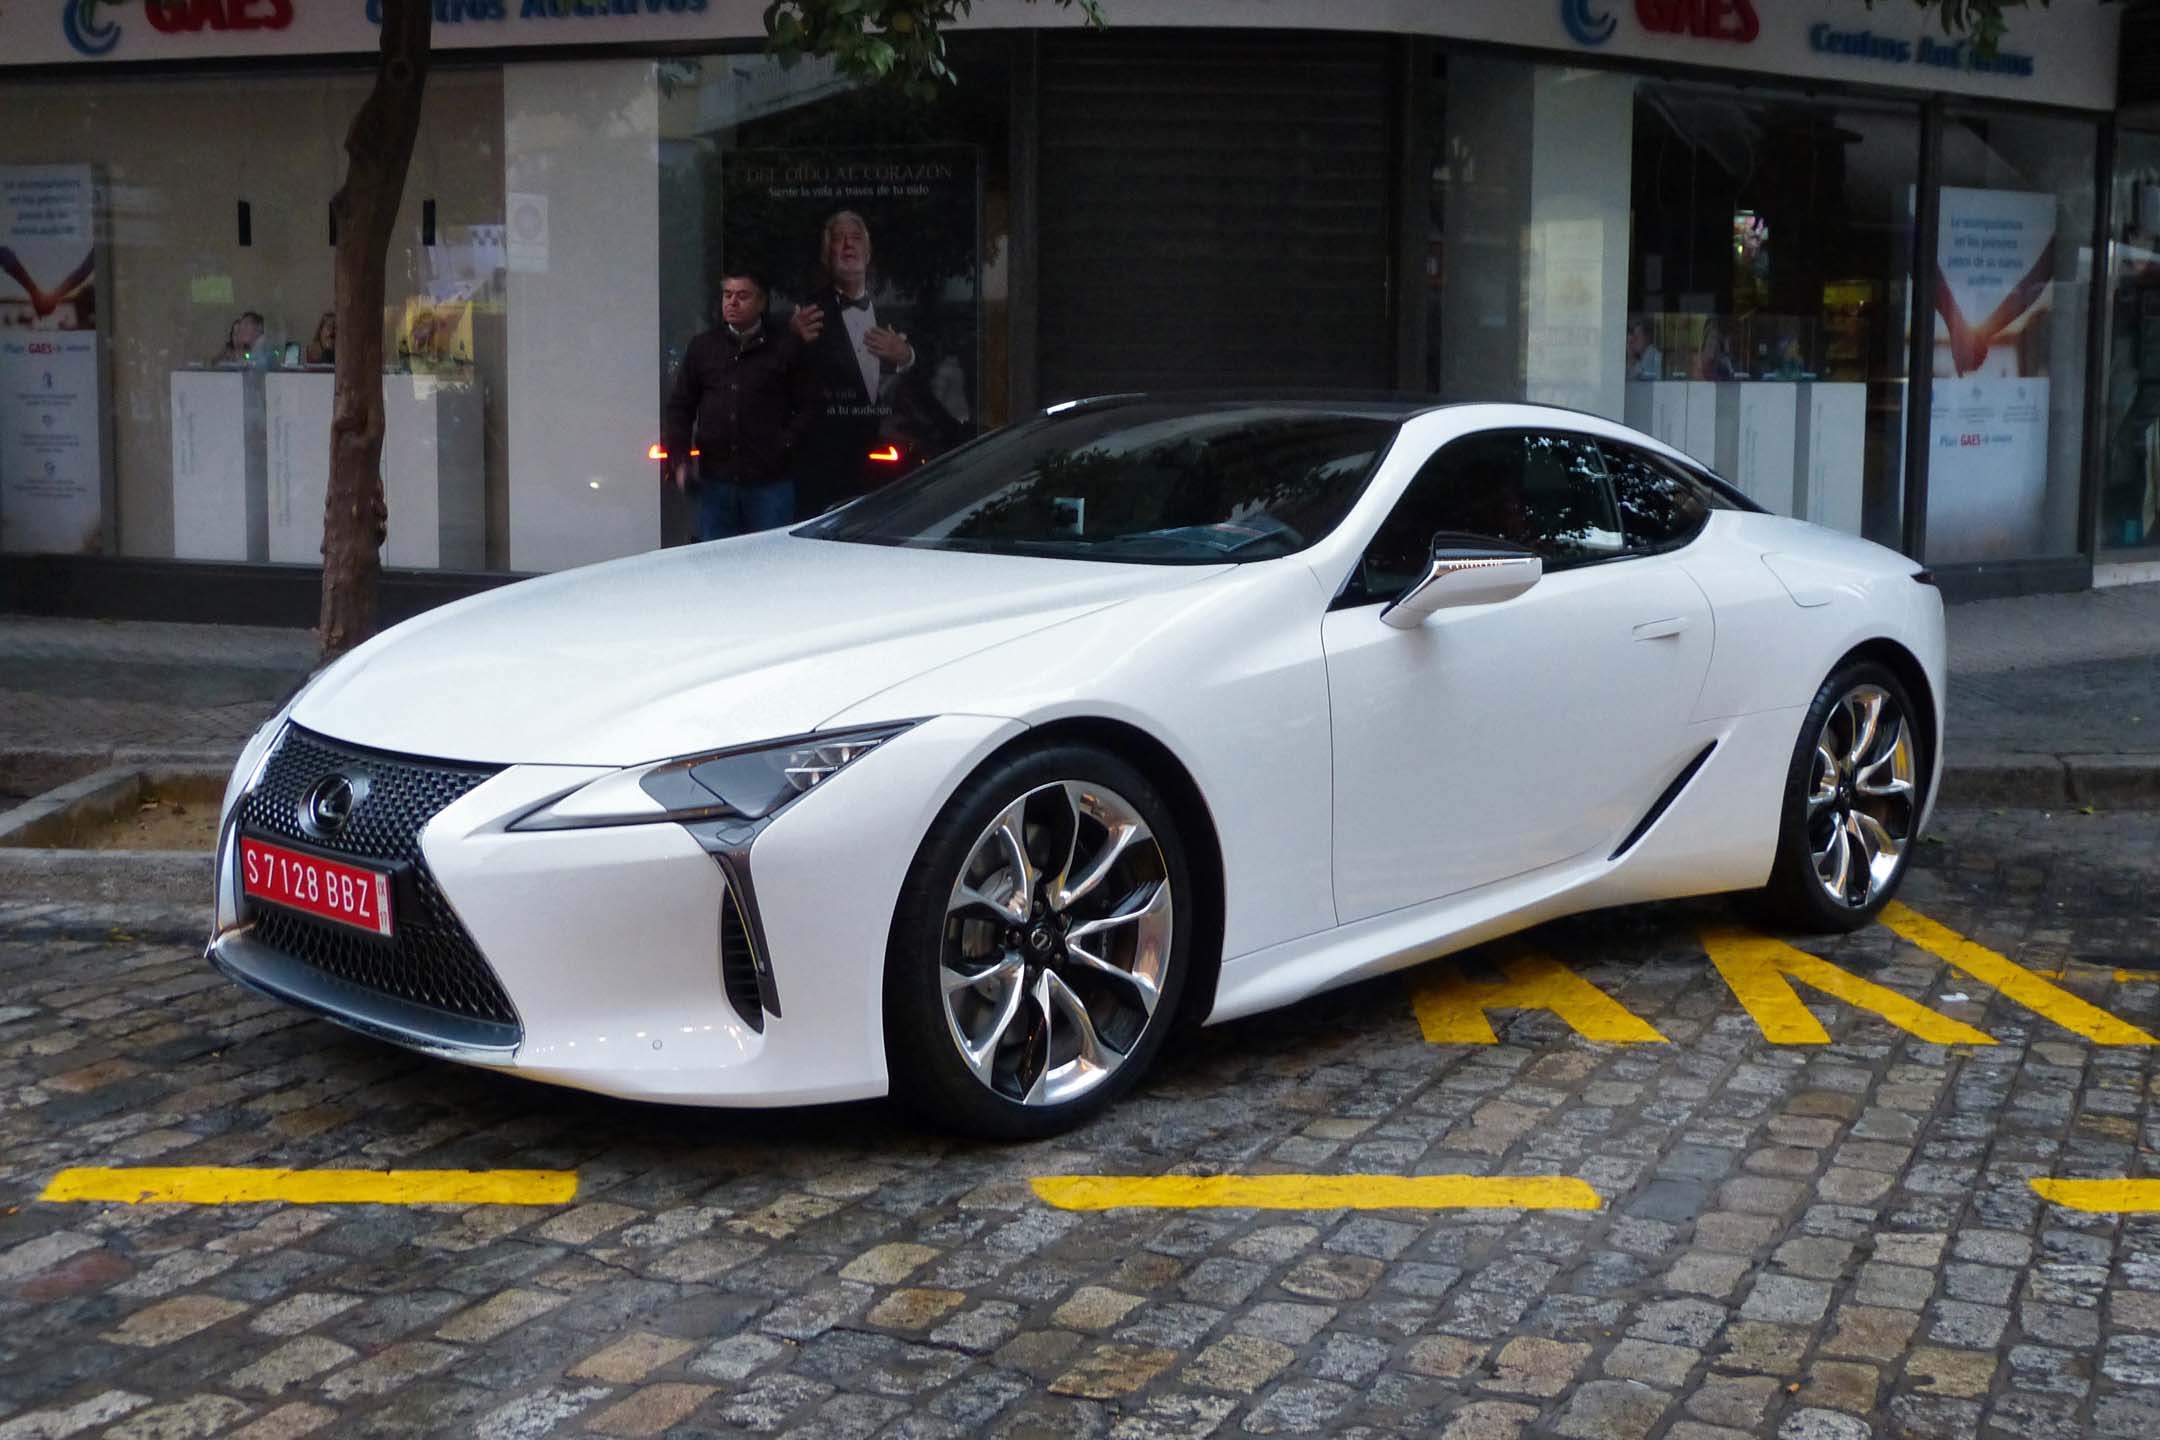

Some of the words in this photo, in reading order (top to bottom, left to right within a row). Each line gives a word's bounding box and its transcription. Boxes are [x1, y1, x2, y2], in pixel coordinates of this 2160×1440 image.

[247, 849, 260, 884] S
[263, 853, 319, 902] 7128
[326, 870, 371, 917] BBZ
